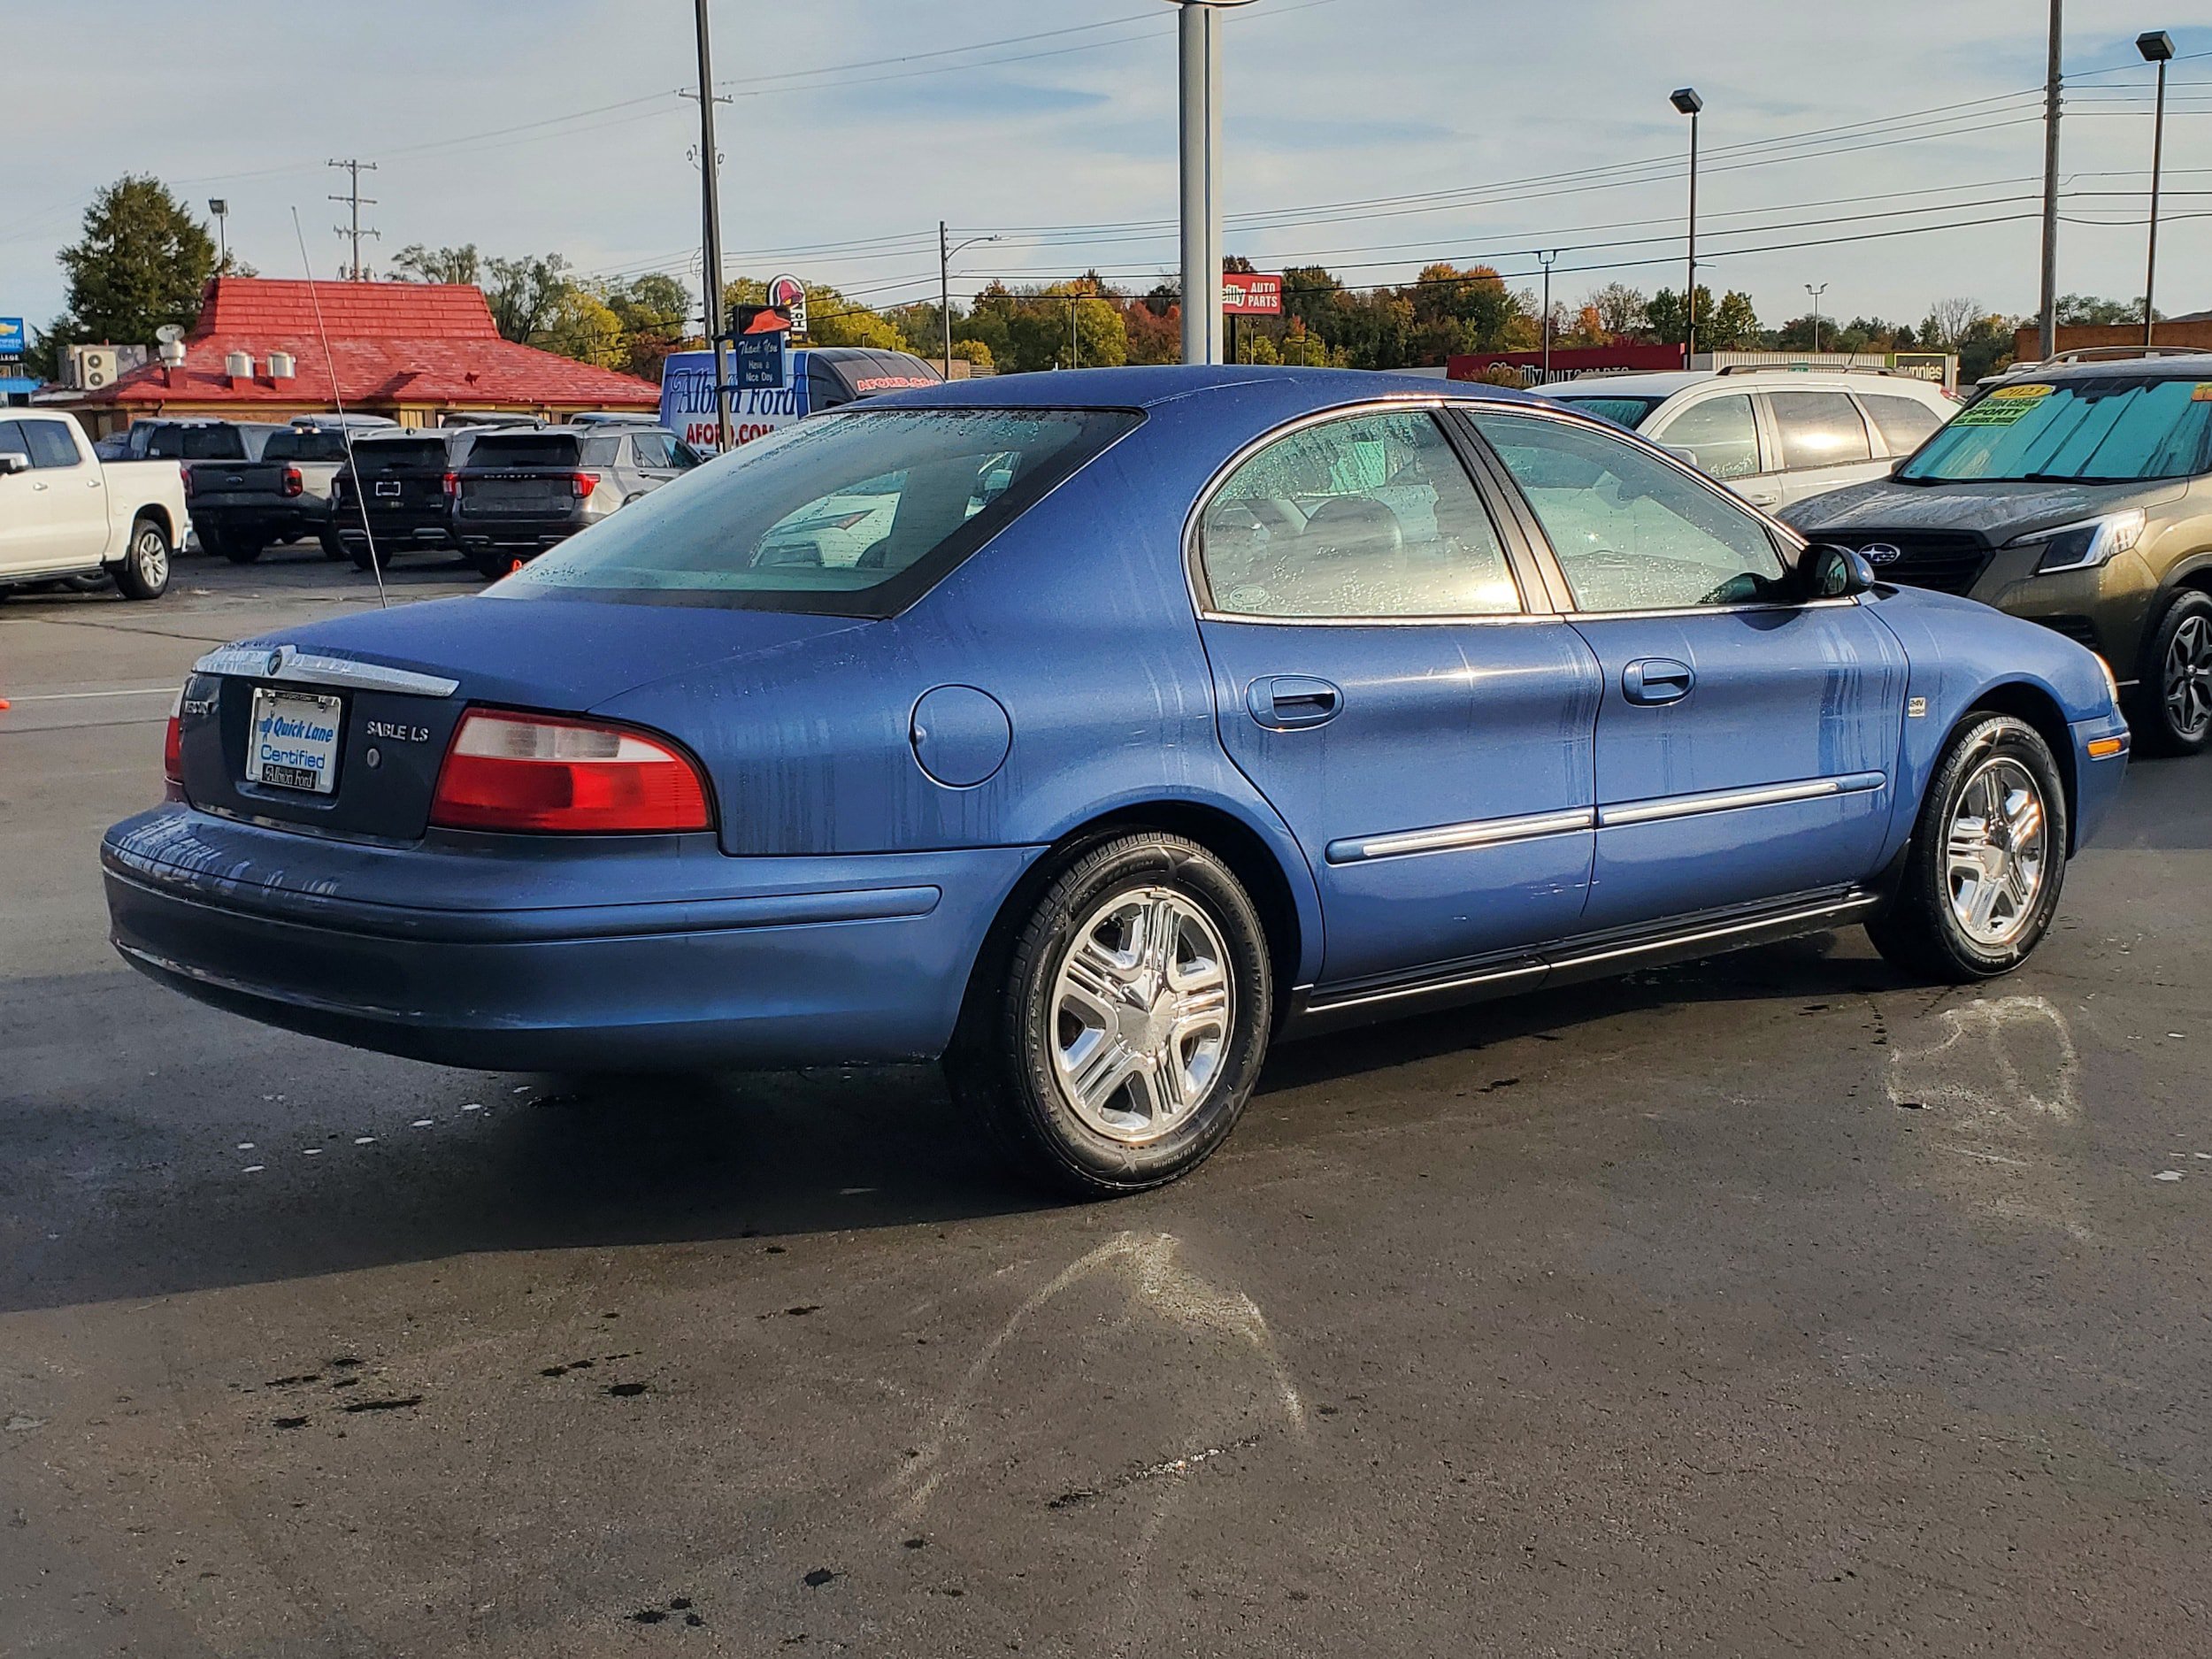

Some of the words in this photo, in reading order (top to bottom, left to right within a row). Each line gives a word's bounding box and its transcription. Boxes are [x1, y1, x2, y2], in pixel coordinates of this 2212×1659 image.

[1250, 282, 1276, 294] AUTO
[1248, 295, 1278, 307] PARTS
[273, 716, 304, 739] Quick
[304, 721, 334, 742] Lane
[366, 720, 407, 741] SABLE
[411, 726, 429, 741] LS
[261, 744, 326, 769] Certified
[265, 764, 293, 785] Albion
[294, 770, 313, 787] Ford
